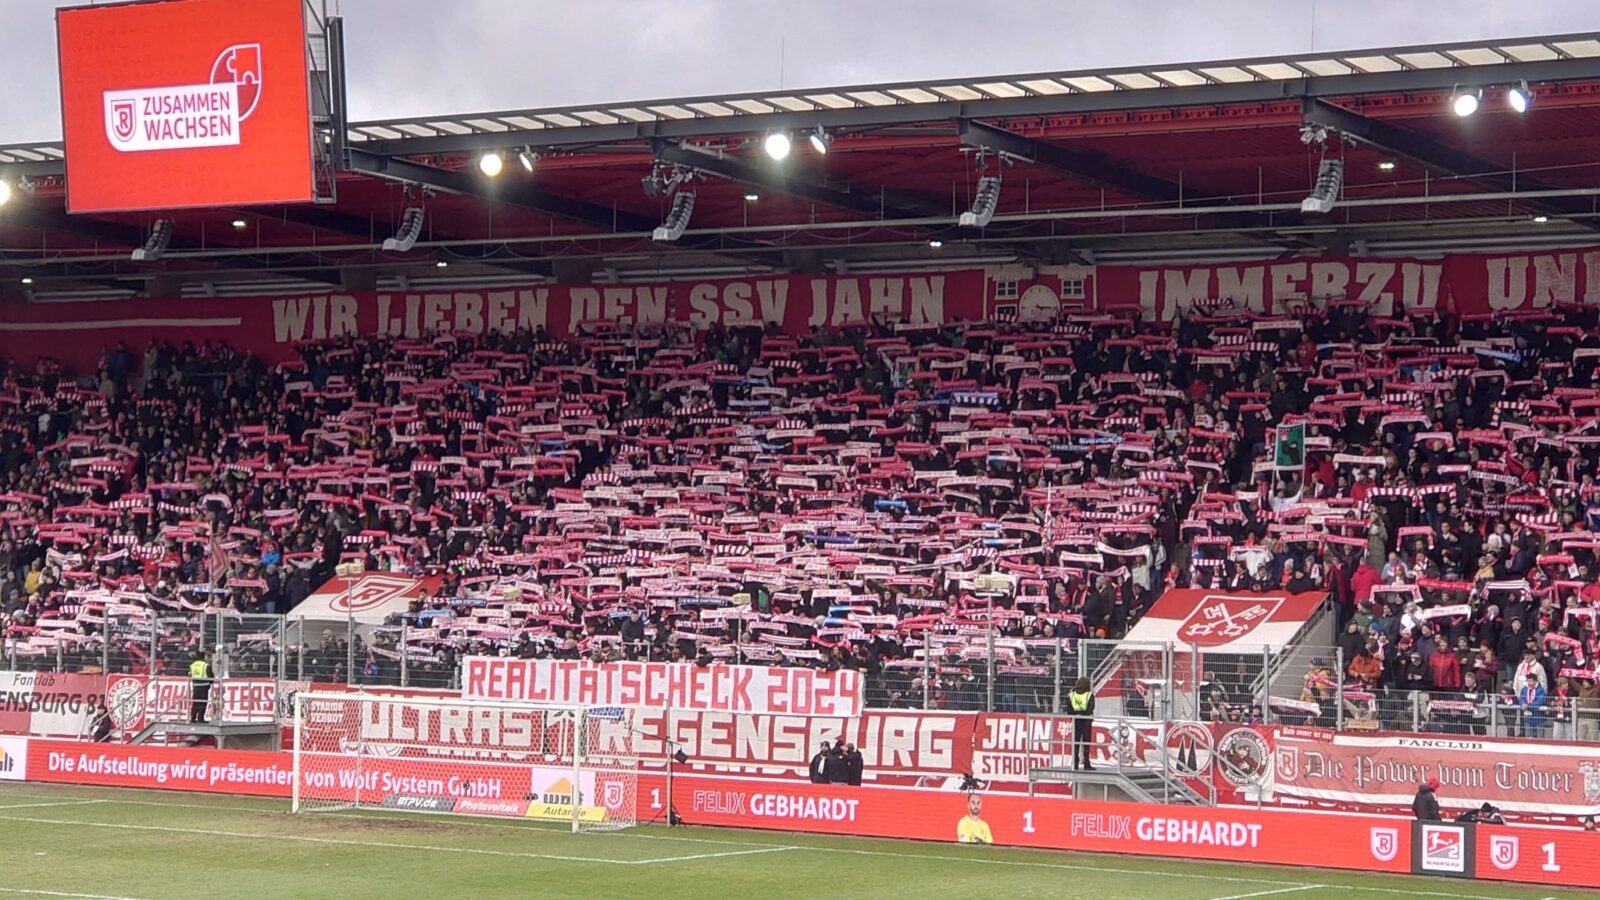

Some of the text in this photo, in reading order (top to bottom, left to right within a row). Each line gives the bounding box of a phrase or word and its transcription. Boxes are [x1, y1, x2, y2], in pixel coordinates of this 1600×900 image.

[143, 91, 230, 116] ZUSAMMEN
[143, 115, 232, 141] WACHSEN
[272, 295, 359, 343] WIR
[376, 287, 550, 340] LIEBEN
[569, 286, 668, 338] DEN
[689, 278, 790, 331] SSV
[808, 275, 945, 327] JAHN
[1139, 261, 1443, 323] IMMERZU
[13, 673, 55, 687] Fanclub
[468, 658, 860, 716] REALITÄTSCHECK 2024
[311, 700, 344, 711] STADION
[311, 712, 344, 723] VERBOT
[361, 694, 533, 748] ULTRAS
[982, 718, 1051, 751] JAHN
[1399, 737, 1483, 750] FANCLUB
[48, 752, 501, 799] Die Aufstellung wird präsentier von Wolf System GmbH
[982, 755, 1051, 775] STADION
[1303, 750, 1575, 793] Die Power vom Tower
[460, 799, 519, 814] Photovoltaik
[543, 805, 587, 818] Autarie
[650, 788, 860, 822] 1 FELIX GEBHARDT
[1021, 811, 1263, 848] 1 FELIX GEBHARDT
[1541, 841, 1561, 872] 1
